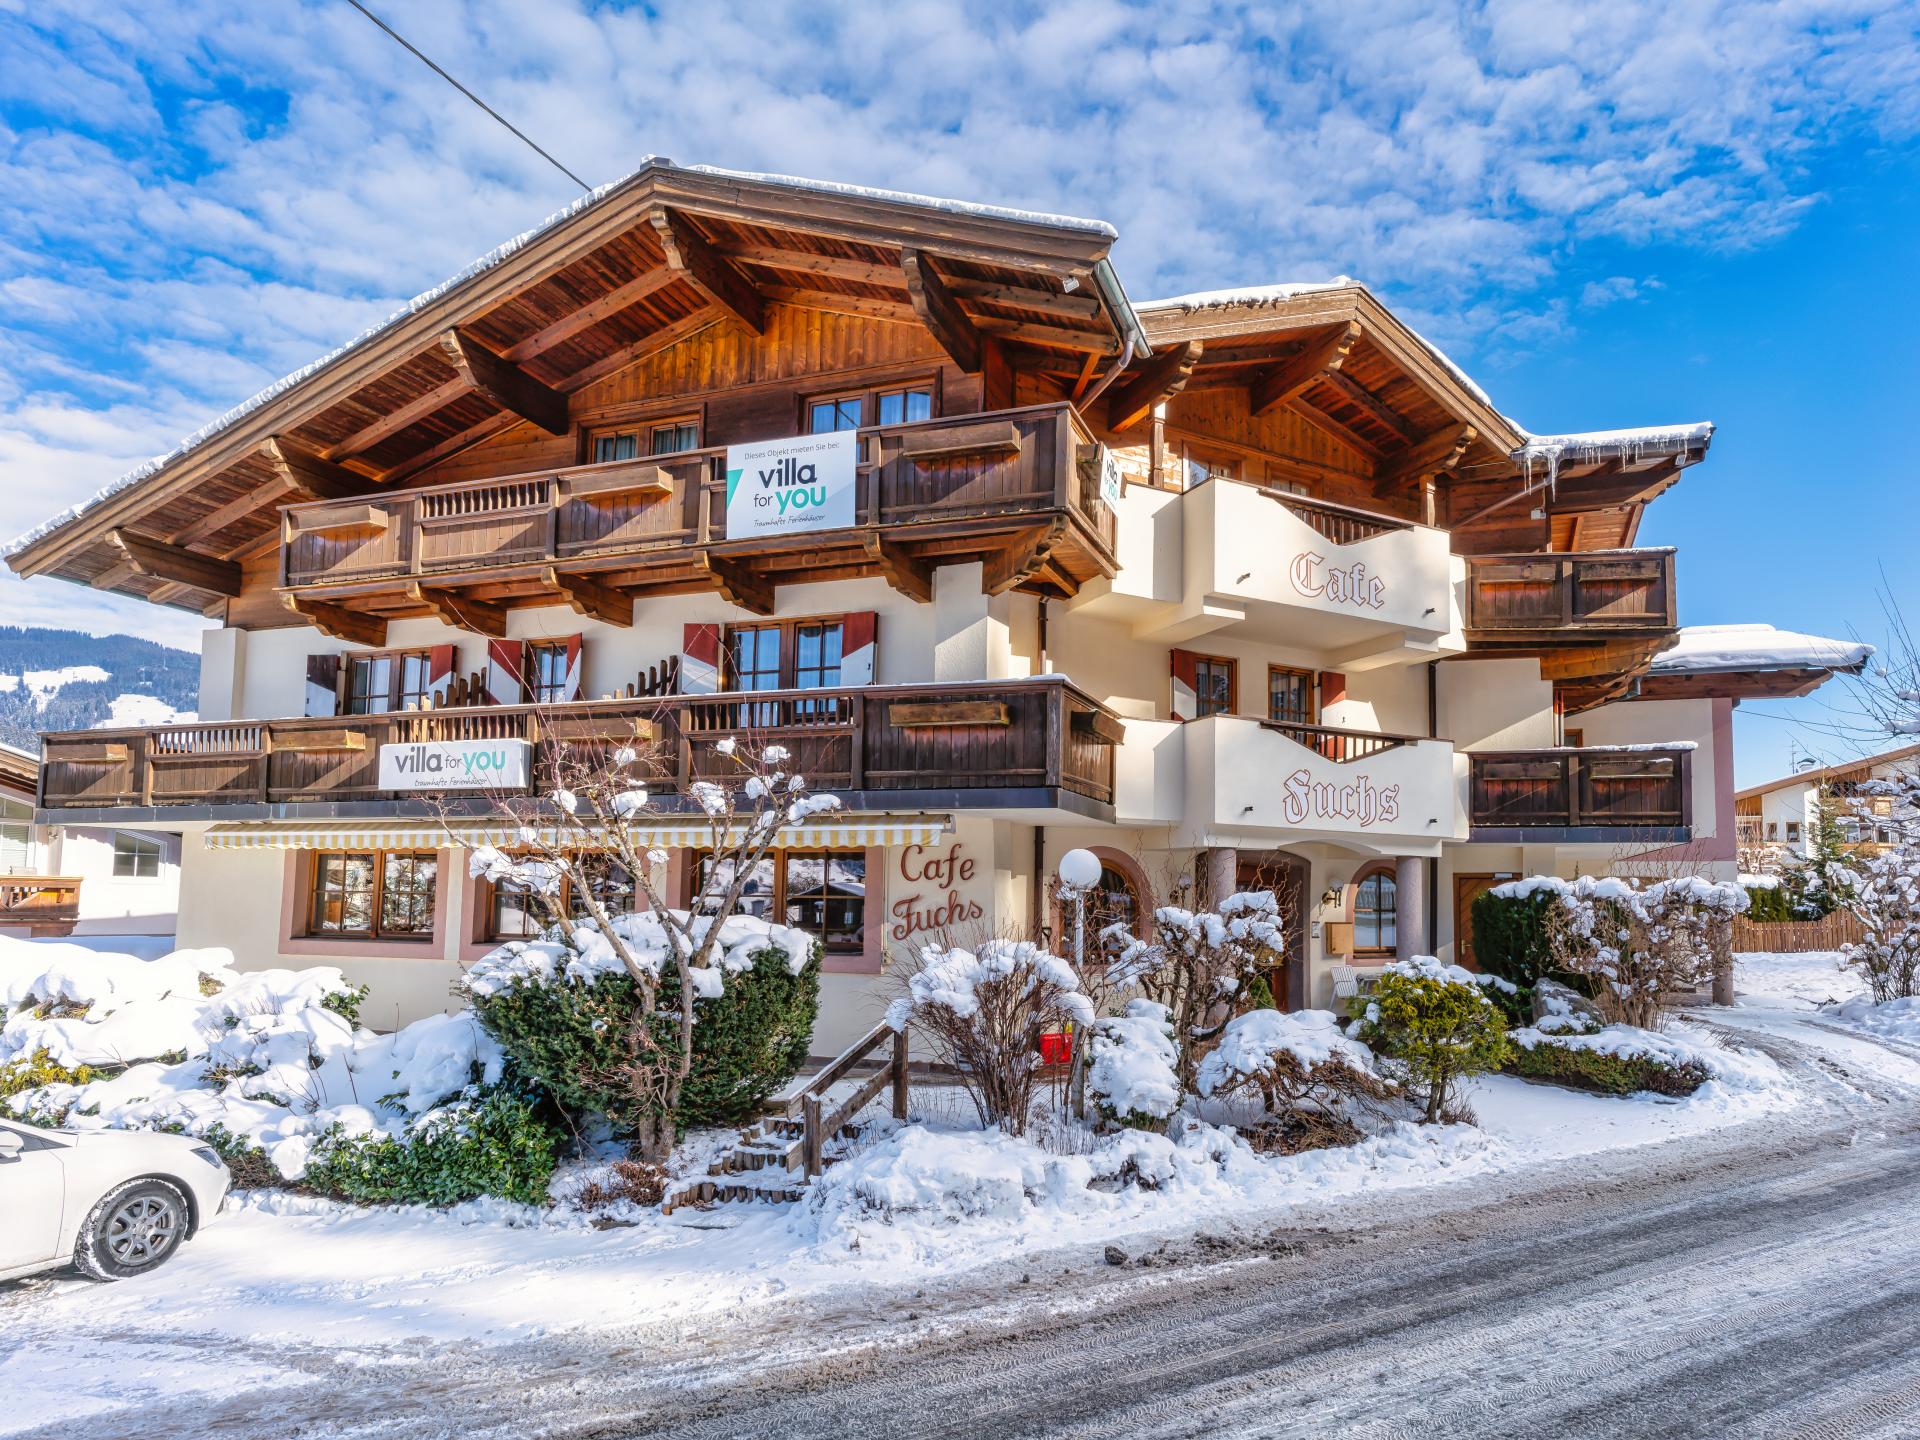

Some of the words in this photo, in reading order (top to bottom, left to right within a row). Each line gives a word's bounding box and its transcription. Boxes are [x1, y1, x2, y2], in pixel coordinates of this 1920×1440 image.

[744, 452, 766, 460] Dieses
[767, 448, 789, 457] Objekt
[790, 445, 814, 454] mieten
[758, 458, 817, 488] villa
[753, 494, 773, 507] for
[775, 486, 826, 515] you
[1290, 551, 1385, 610] Cafe
[395, 746, 443, 774] villa
[445, 755, 462, 768] for
[462, 750, 506, 775] you
[1282, 769, 1400, 827] Fuchs
[900, 843, 975, 889] Cafe
[893, 889, 983, 940] Fuchs
